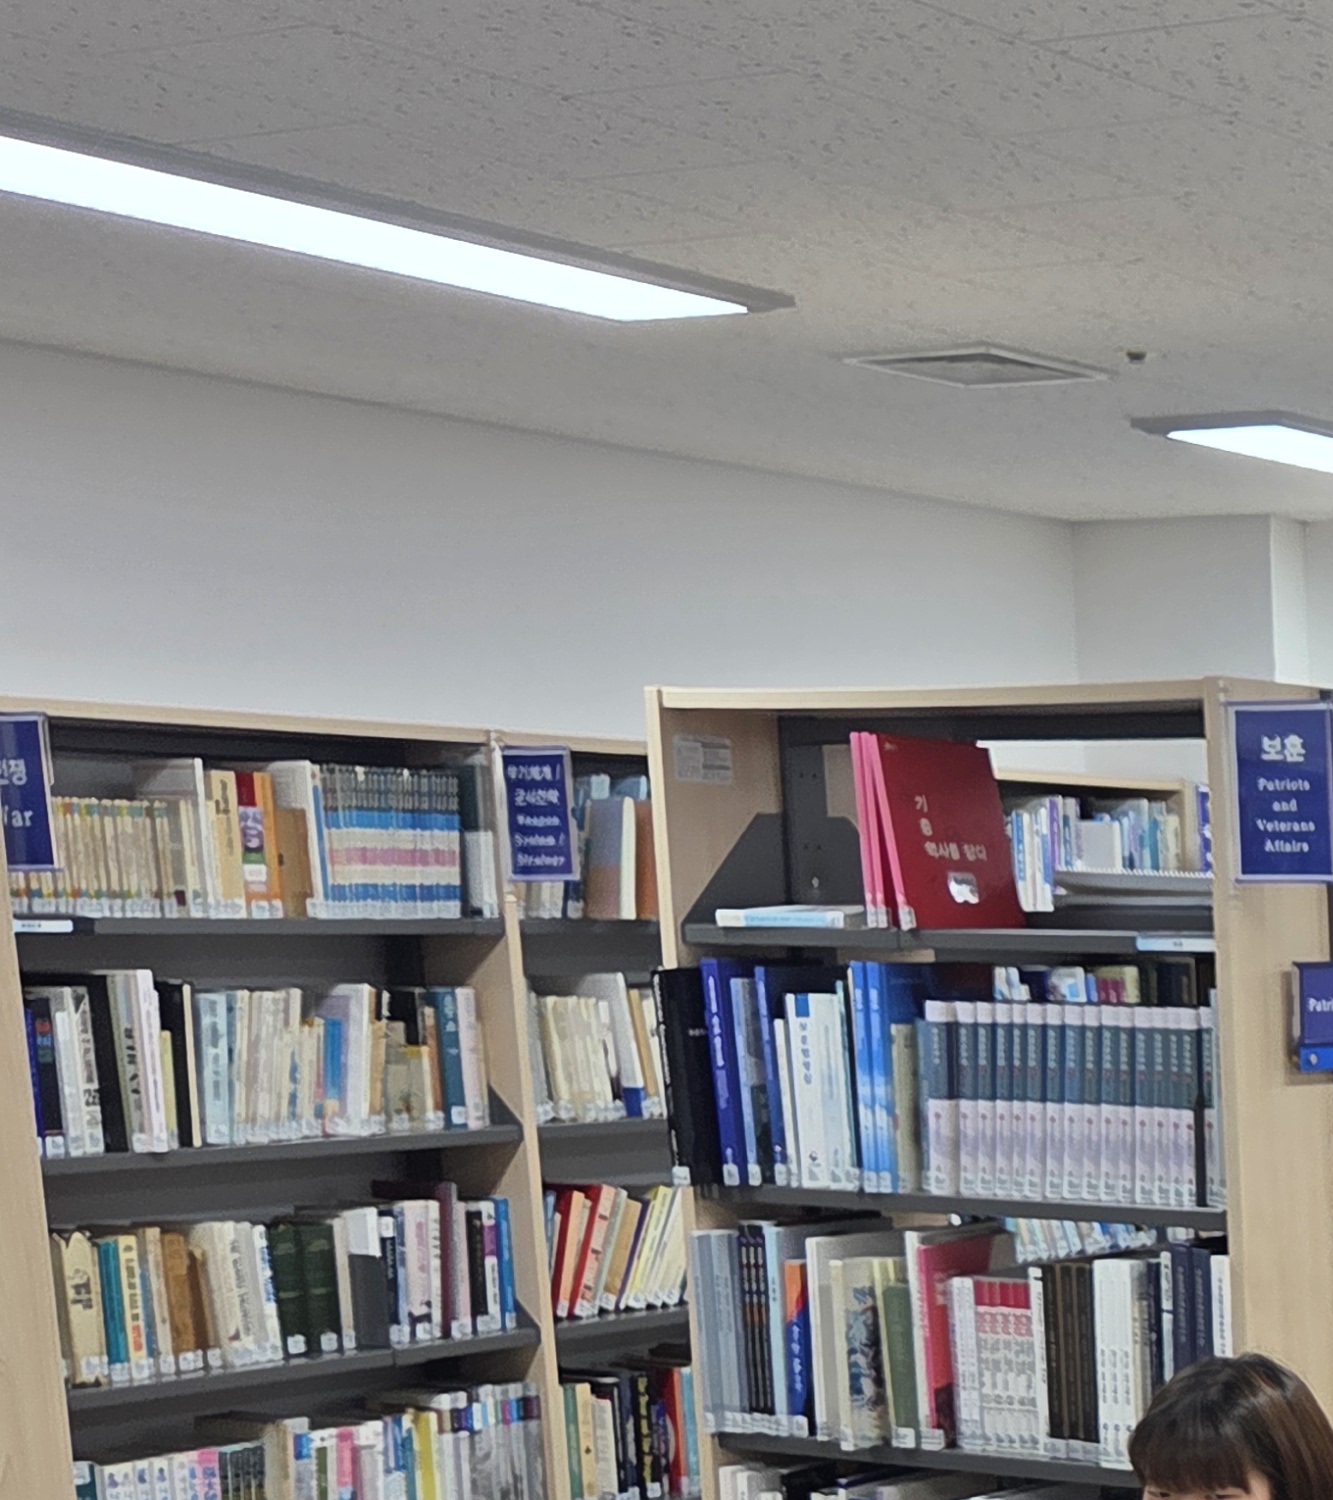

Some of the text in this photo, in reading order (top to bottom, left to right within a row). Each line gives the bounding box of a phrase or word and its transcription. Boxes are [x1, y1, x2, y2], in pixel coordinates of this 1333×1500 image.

[1260, 734, 1307, 763] 보훈
[1256, 777, 1311, 792] Patriots
[1271, 798, 1299, 813] and
[1255, 817, 1316, 833] Veterans
[1264, 839, 1310, 853] Affairs
